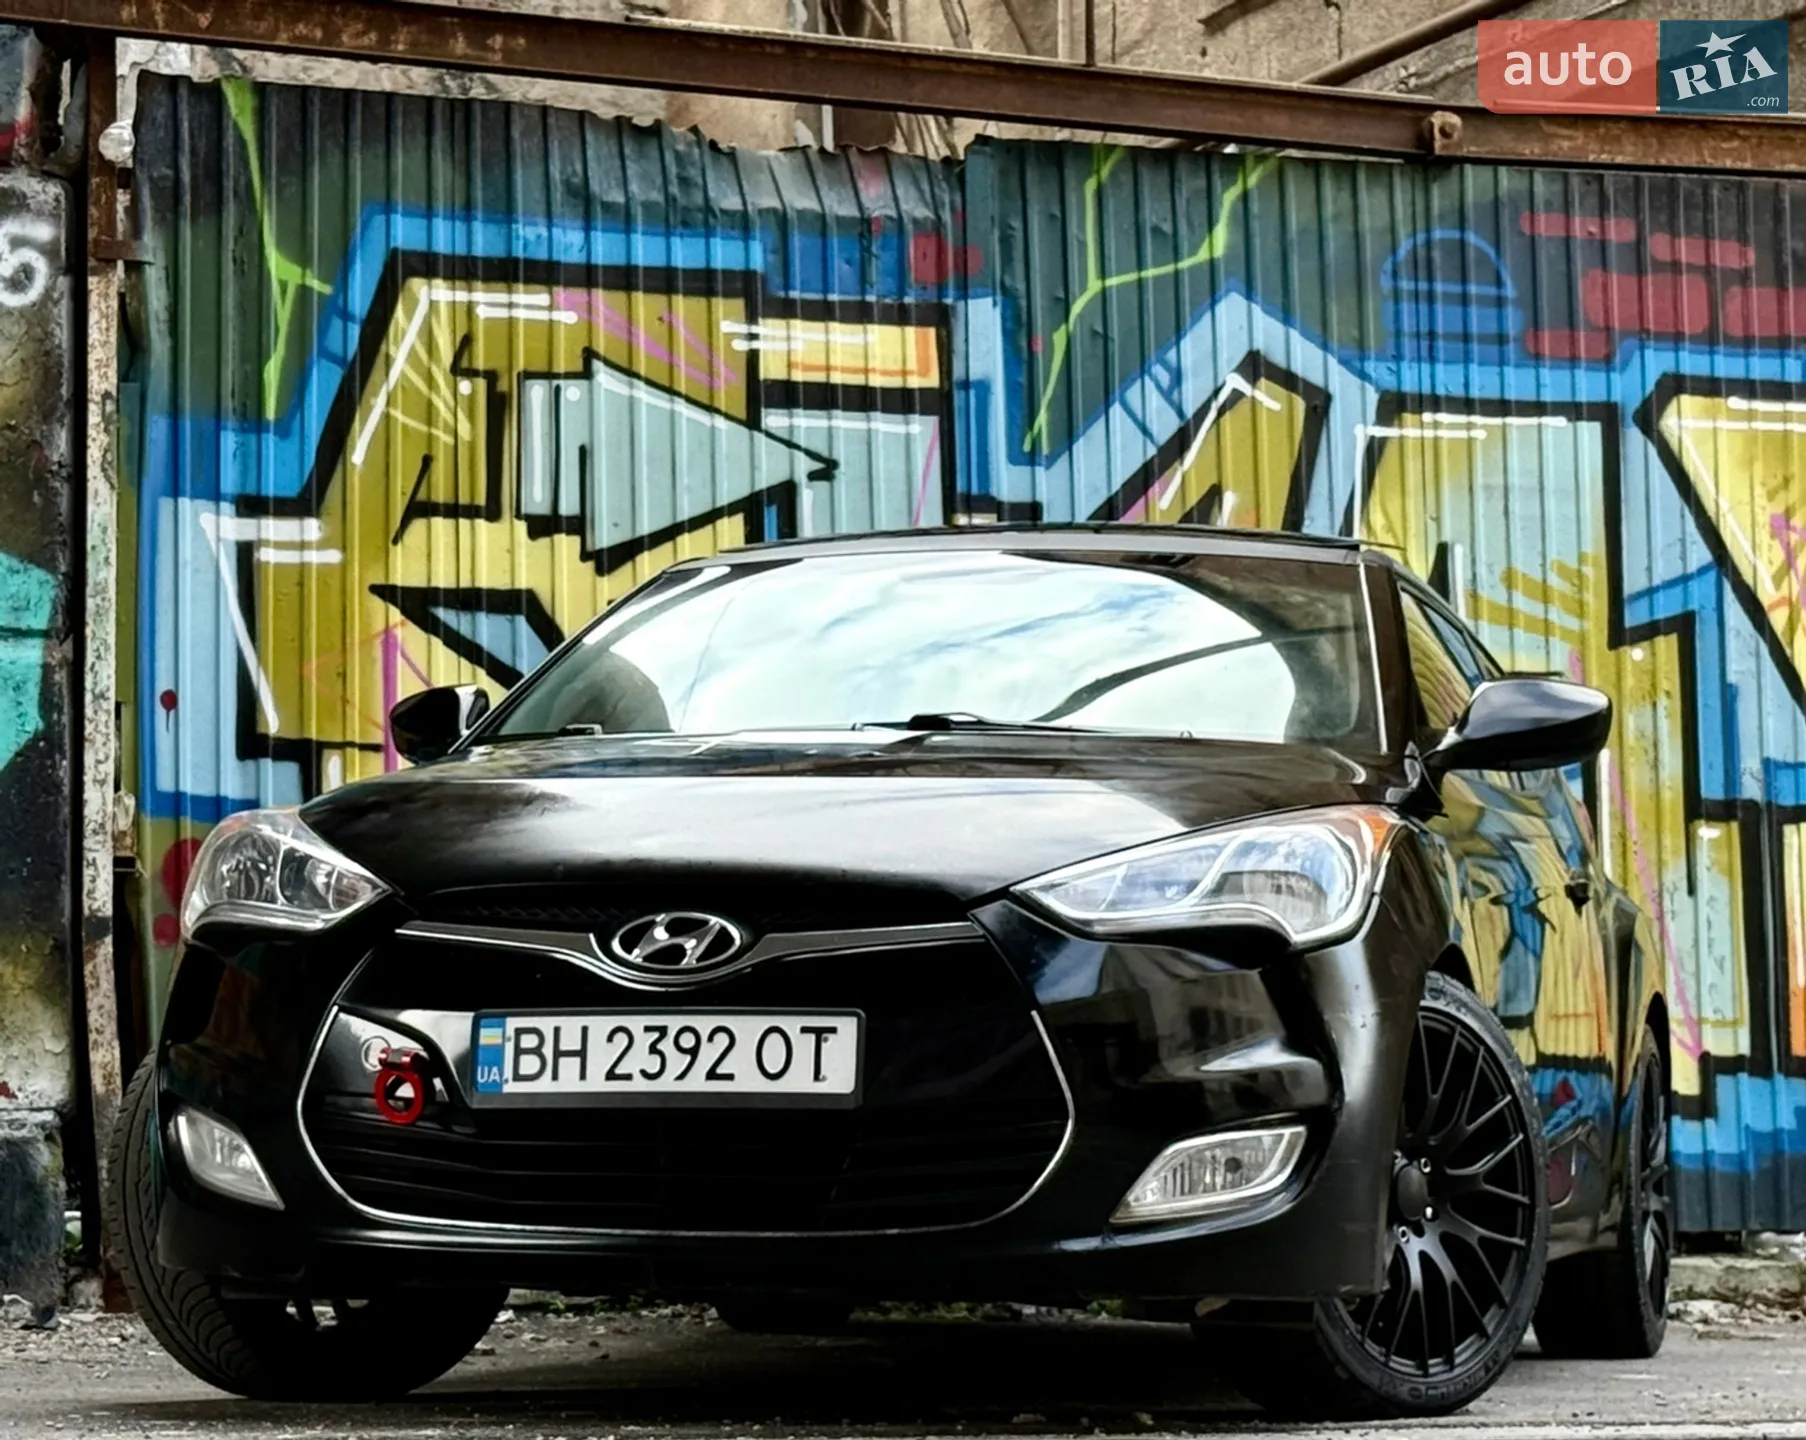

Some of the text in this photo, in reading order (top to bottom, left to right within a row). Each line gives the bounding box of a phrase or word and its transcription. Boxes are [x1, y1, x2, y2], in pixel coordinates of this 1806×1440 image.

[511, 1025, 838, 1082] BH 2392 OT
[477, 1066, 500, 1083] UA
